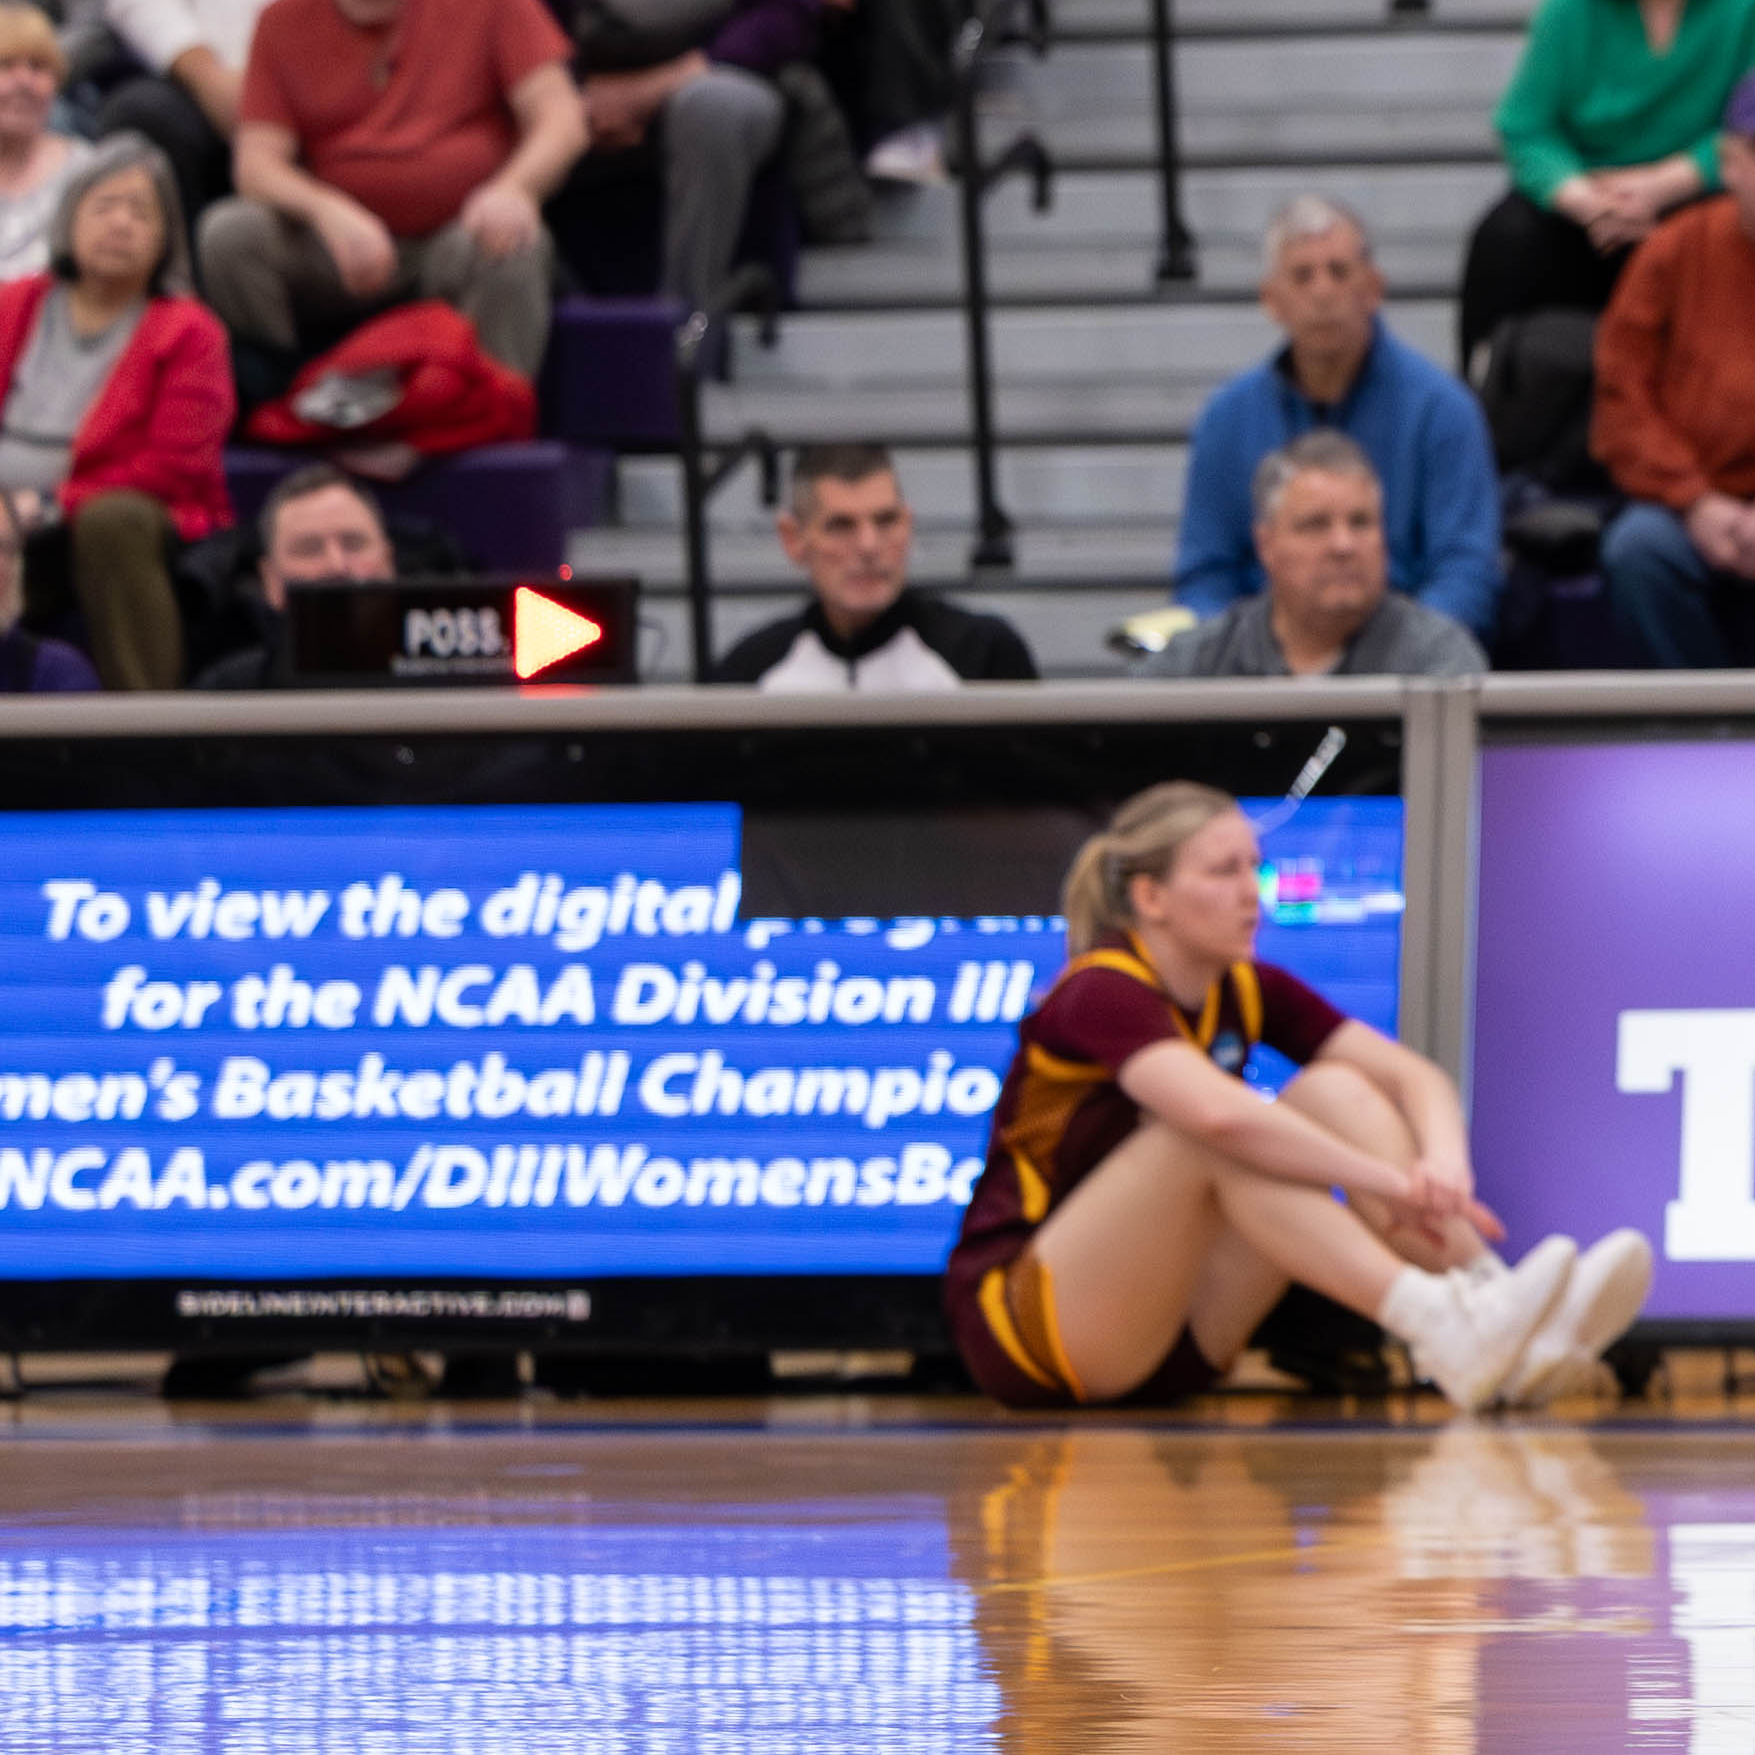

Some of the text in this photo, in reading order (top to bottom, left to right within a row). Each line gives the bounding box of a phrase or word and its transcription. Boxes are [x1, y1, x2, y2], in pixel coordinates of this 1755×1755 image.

[44, 880, 130, 941] To
[146, 878, 330, 939] view
[341, 874, 469, 938] the
[481, 871, 741, 952] digital
[103, 966, 222, 1030] for
[232, 965, 361, 1029] the
[373, 964, 596, 1027] NCAA
[613, 957, 936, 1025] Division
[213, 1050, 631, 1119] Basketball
